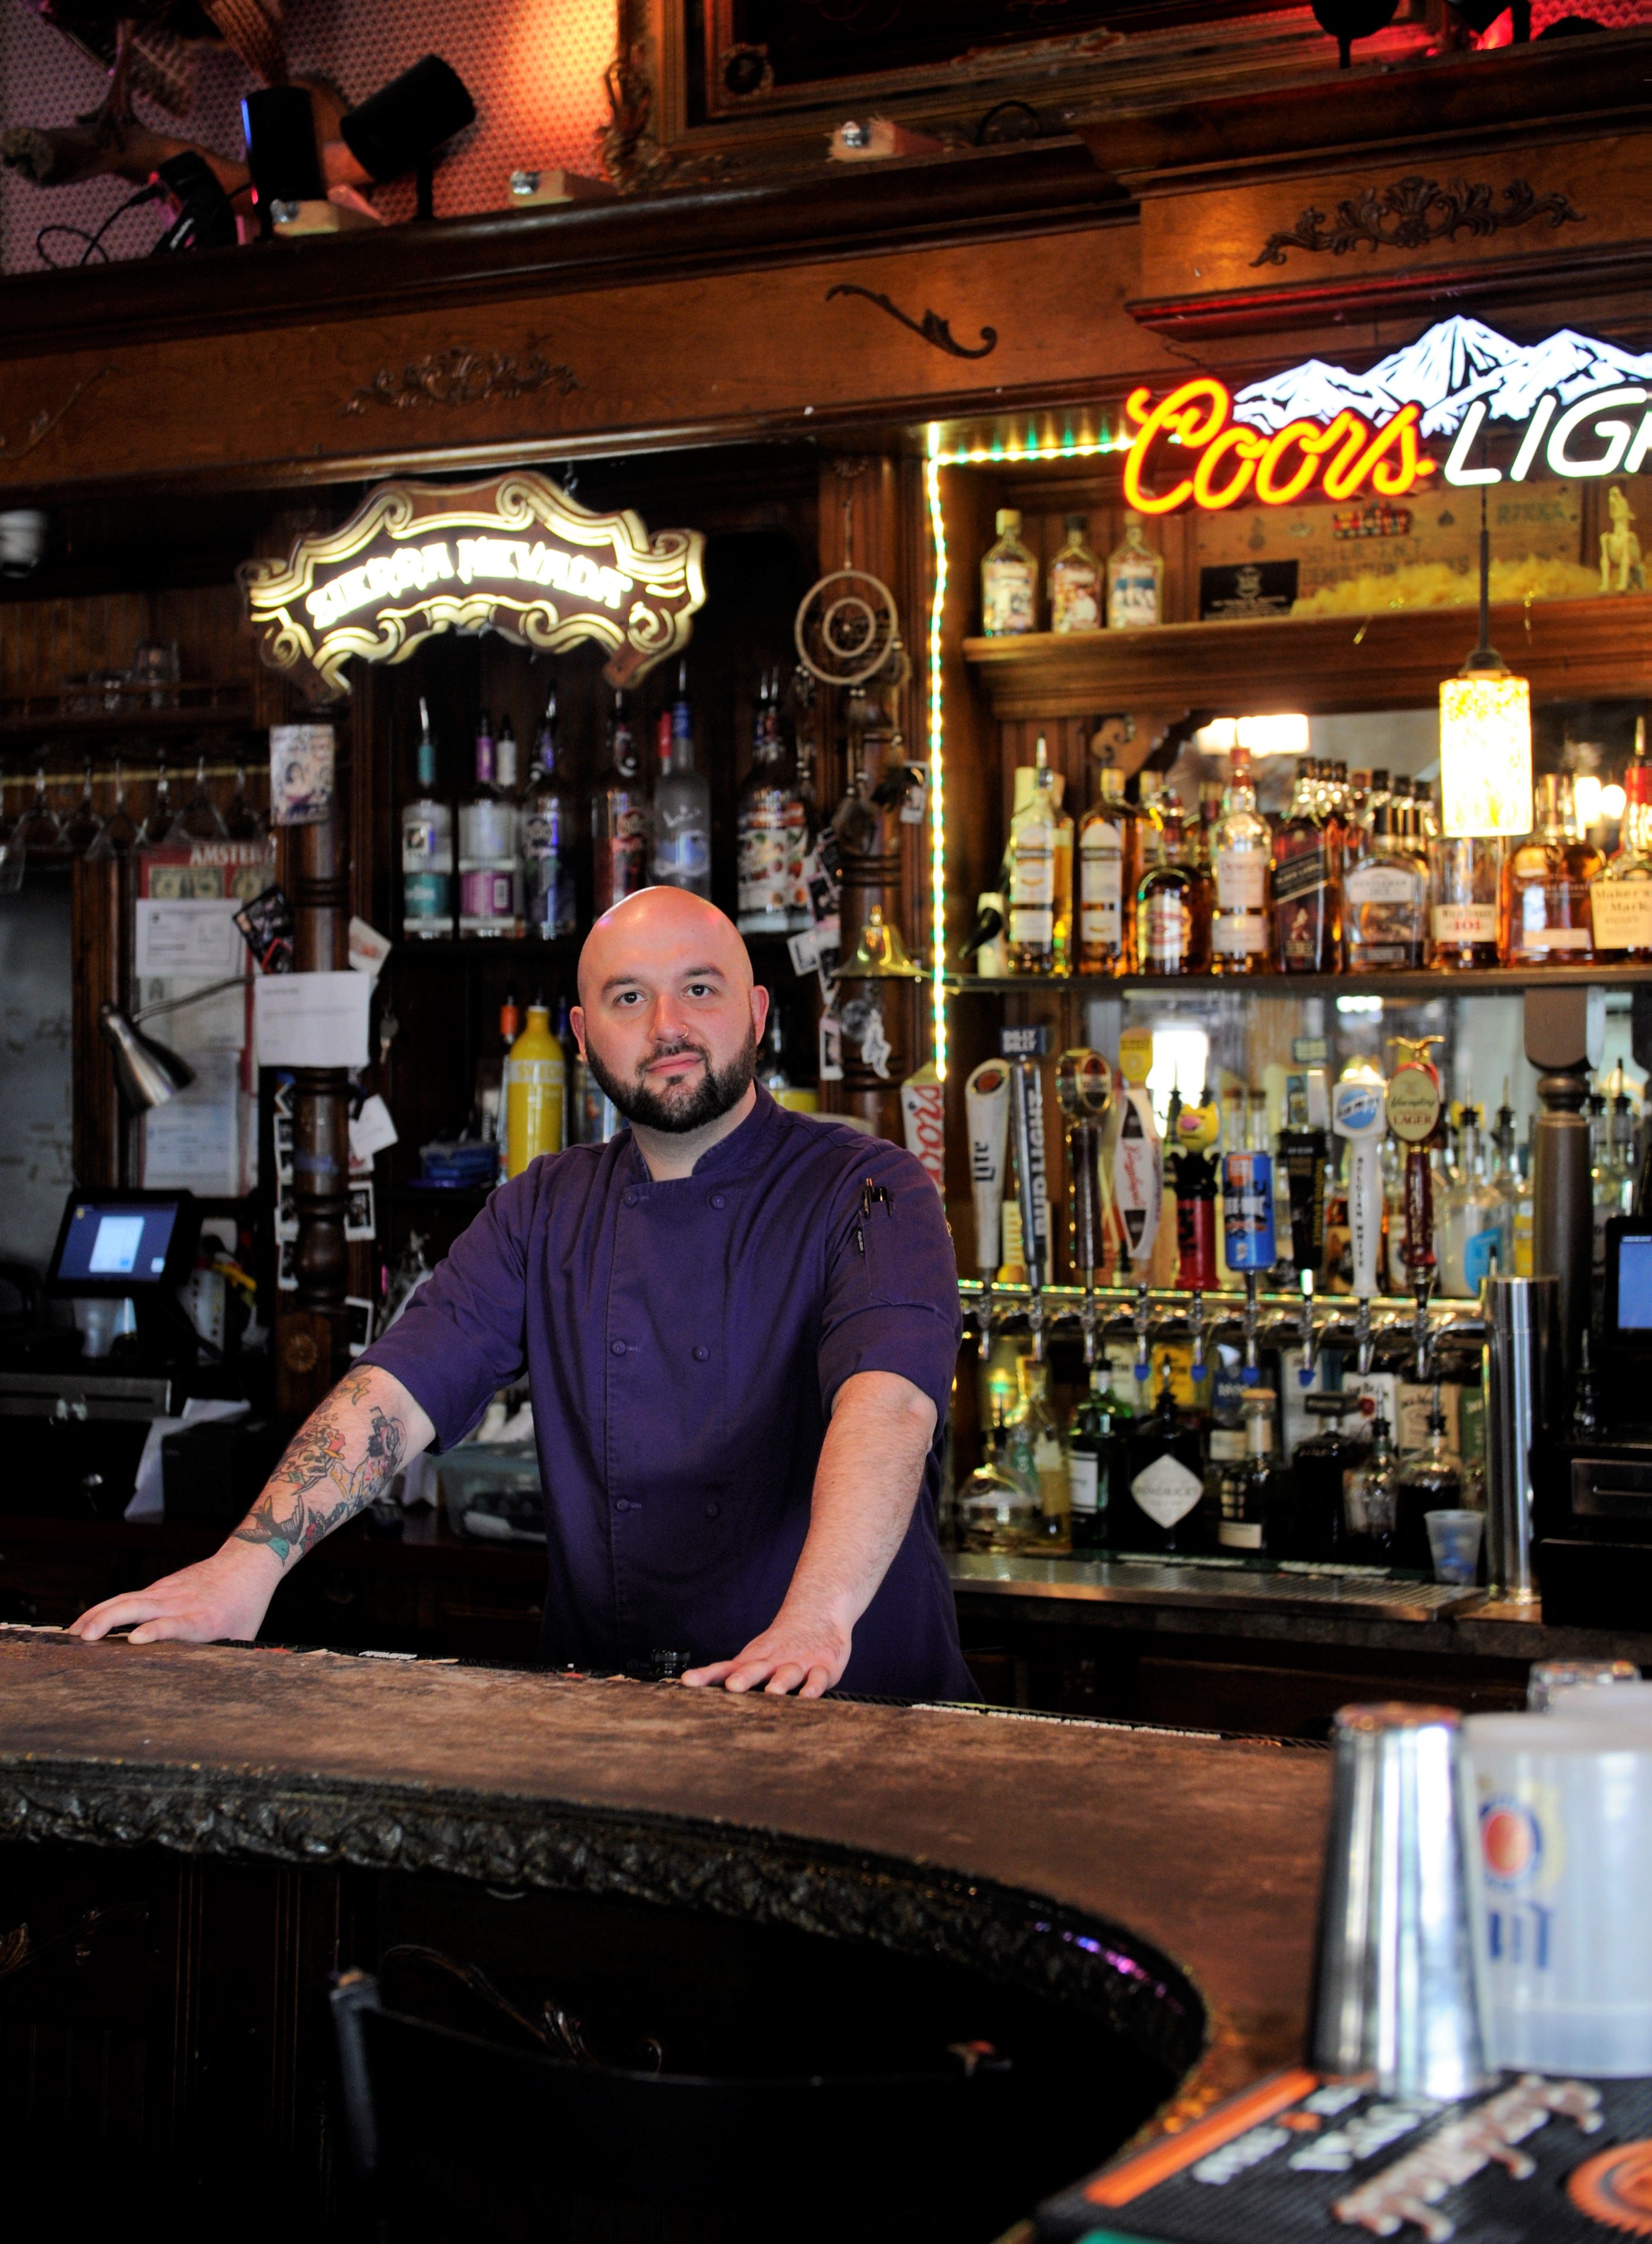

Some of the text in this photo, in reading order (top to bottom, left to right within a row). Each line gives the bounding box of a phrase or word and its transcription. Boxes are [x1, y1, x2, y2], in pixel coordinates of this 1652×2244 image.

[1123, 377, 1437, 515] Coors
[304, 535, 634, 631] SIERRA NEVADA
[1454, 918, 1482, 932] 101
[1026, 1087, 1049, 1237] BUD LIGHT
[1392, 1112, 1433, 1125] LAGER
